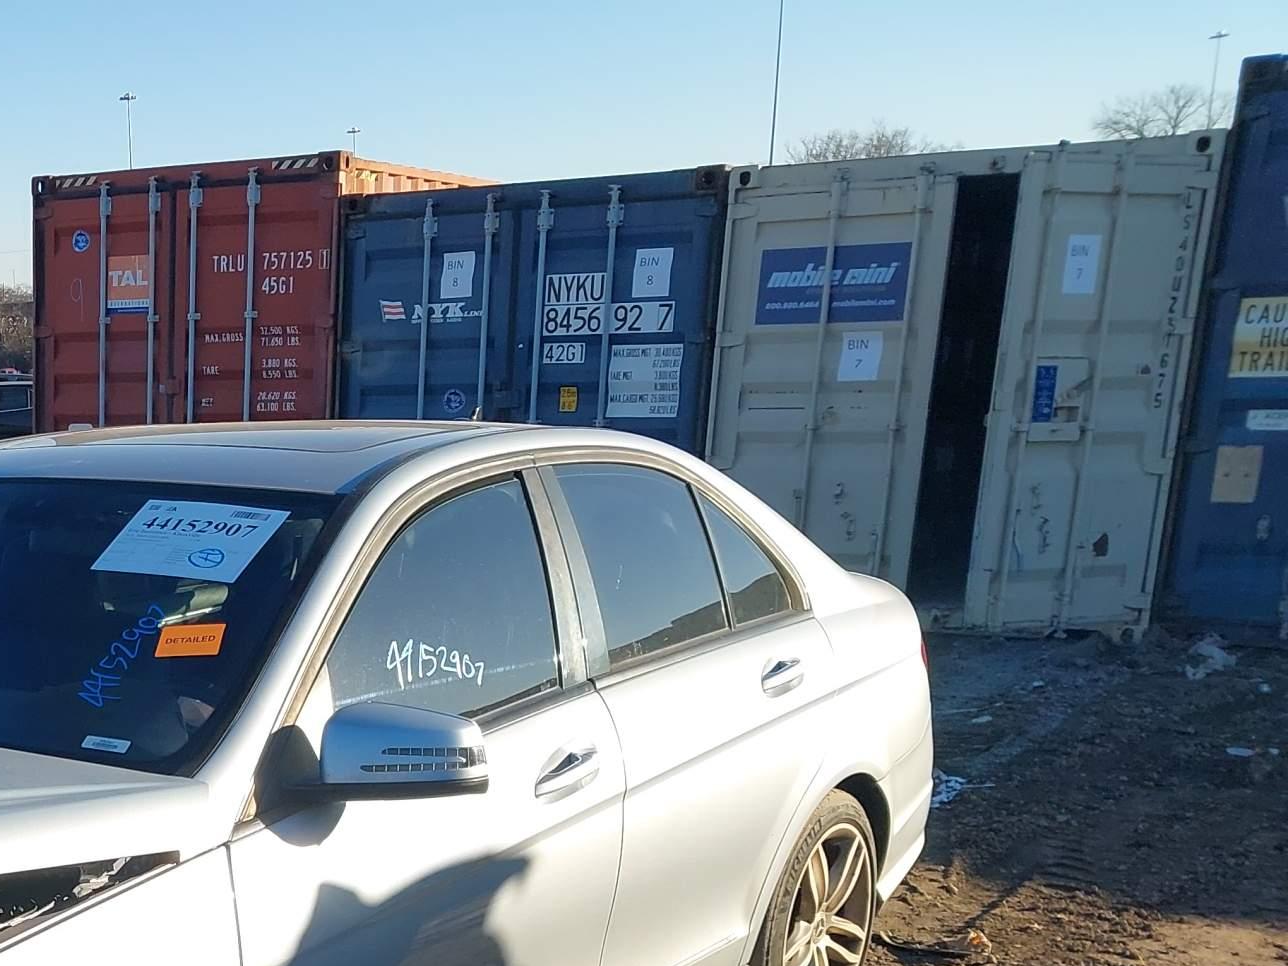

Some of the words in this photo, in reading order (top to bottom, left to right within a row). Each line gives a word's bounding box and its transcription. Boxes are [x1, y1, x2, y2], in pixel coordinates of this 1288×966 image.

[1071, 245, 1090, 257] BIN
[212, 253, 245, 273] TRLU
[262, 250, 313, 270] 757125
[447, 259, 465, 271] BIN
[639, 256, 661, 267] BIN
[108, 270, 149, 287] TAL
[767, 263, 842, 289] mobie
[843, 262, 900, 286] mini
[1076, 267, 1084, 280] 7
[261, 276, 294, 295] 45G1
[452, 277, 460, 288] 8
[646, 275, 655, 286] 8
[546, 273, 605, 303] NYKU
[657, 303, 673, 331] 7
[847, 339, 869, 350] BIN
[544, 344, 585, 362] 42G1
[854, 359, 863, 369] 7
[201, 366, 220, 376] TARE
[142, 515, 259, 538] 44152907
[165, 635, 216, 646] DETAILED
[386, 638, 484, 691] 44152907
